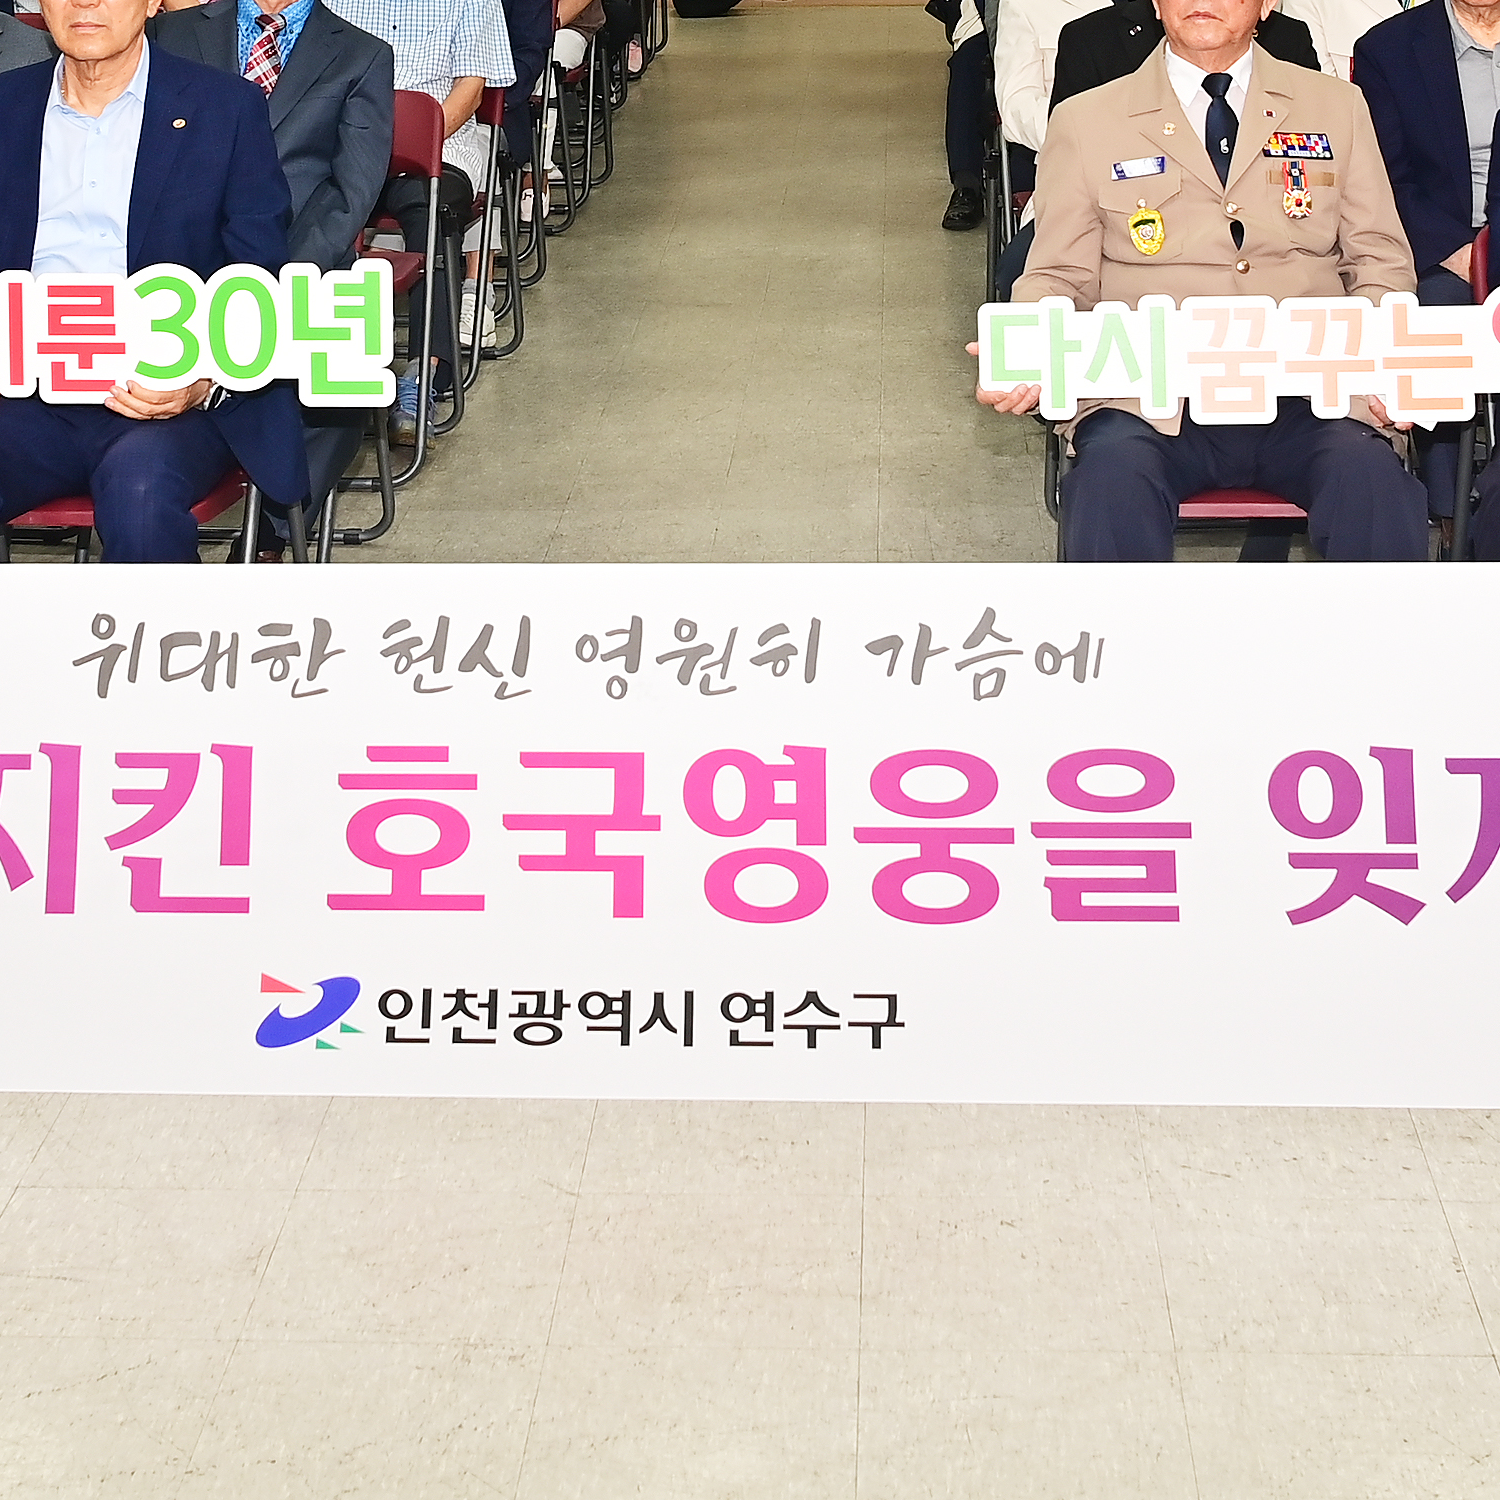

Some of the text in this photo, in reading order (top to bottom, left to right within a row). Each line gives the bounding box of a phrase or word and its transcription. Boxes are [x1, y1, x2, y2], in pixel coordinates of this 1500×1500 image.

[989, 306, 1167, 409] 다시
[1187, 303, 1473, 413] 꿈꾸는
[72, 606, 1105, 702] 위대한 헌신 영원히 가슴에
[327, 744, 1193, 925] 호국영웅을
[377, 987, 906, 1050] 인천광역시 연수구
